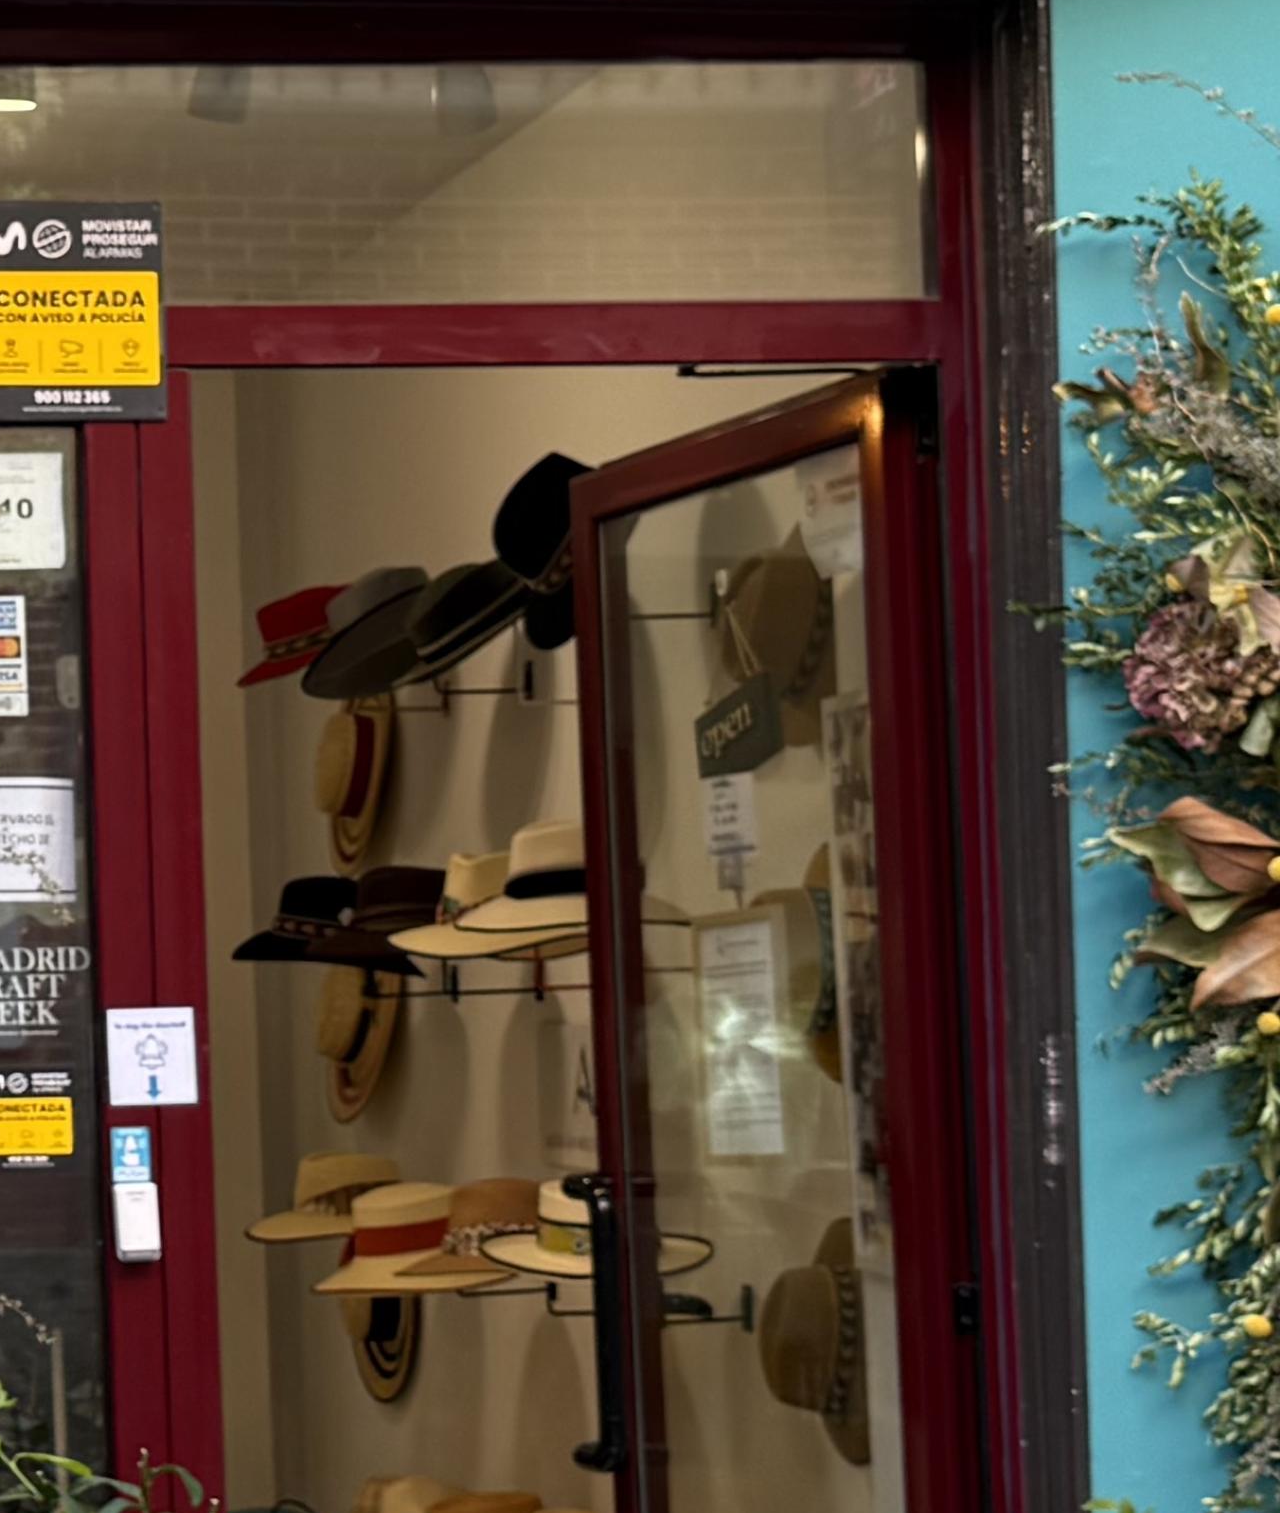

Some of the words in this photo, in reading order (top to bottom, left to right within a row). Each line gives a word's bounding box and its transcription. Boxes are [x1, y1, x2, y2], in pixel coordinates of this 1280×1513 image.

[81, 220, 152, 232] MOVISTAR
[81, 233, 159, 246] PROSEGUR
[31, 312, 74, 323] AVISO
[78, 313, 87, 323] A
[90, 309, 146, 323] POLICÍA
[701, 703, 752, 758] open
